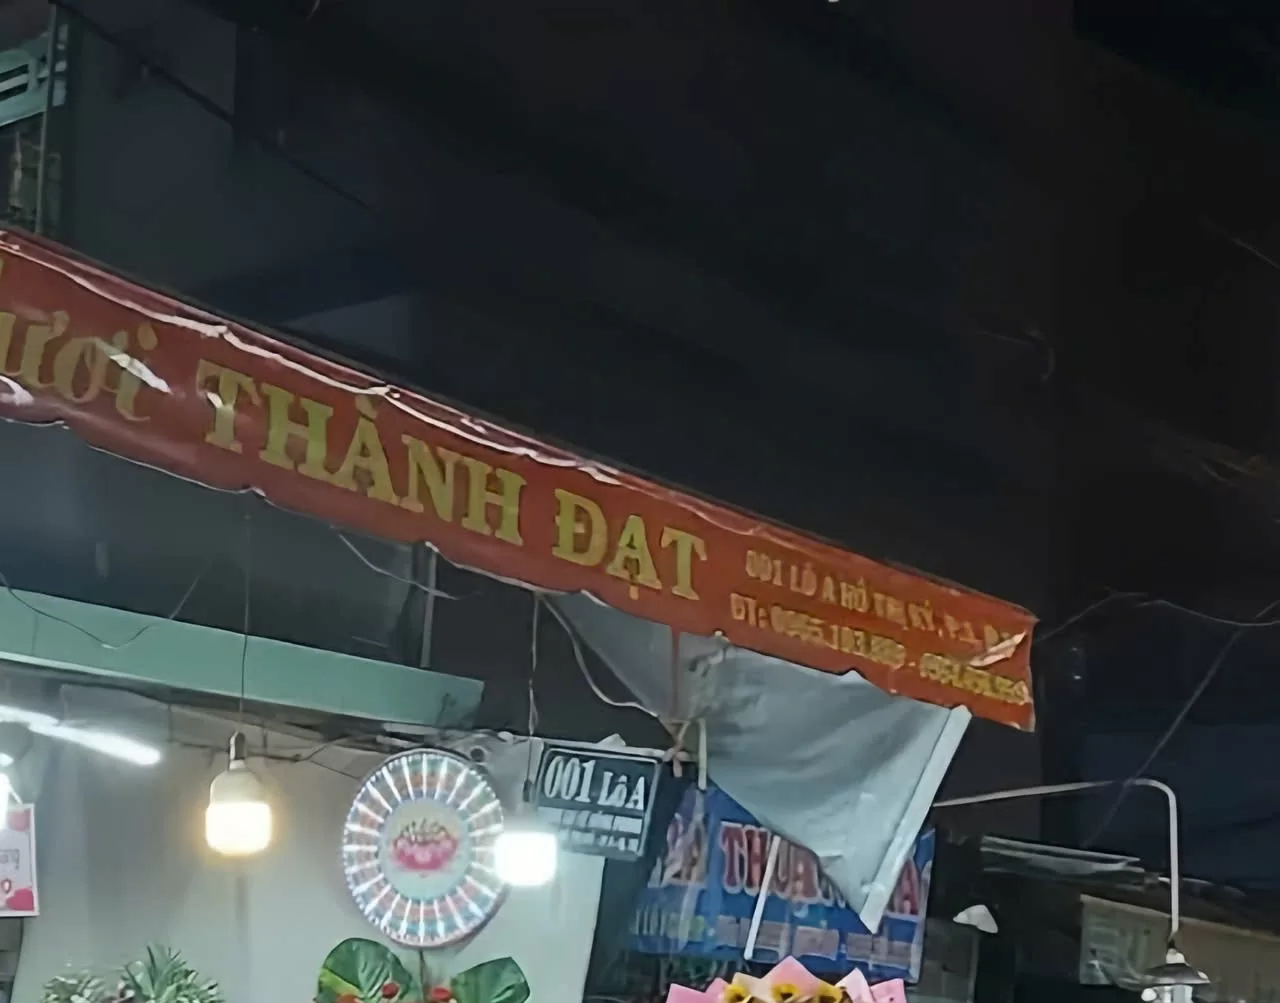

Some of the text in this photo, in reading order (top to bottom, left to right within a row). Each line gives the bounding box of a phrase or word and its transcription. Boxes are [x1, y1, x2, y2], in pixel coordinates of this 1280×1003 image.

[195, 357, 526, 547] THÀNH
[551, 488, 707, 601] ĐẠT
[543, 755, 597, 803] 001
